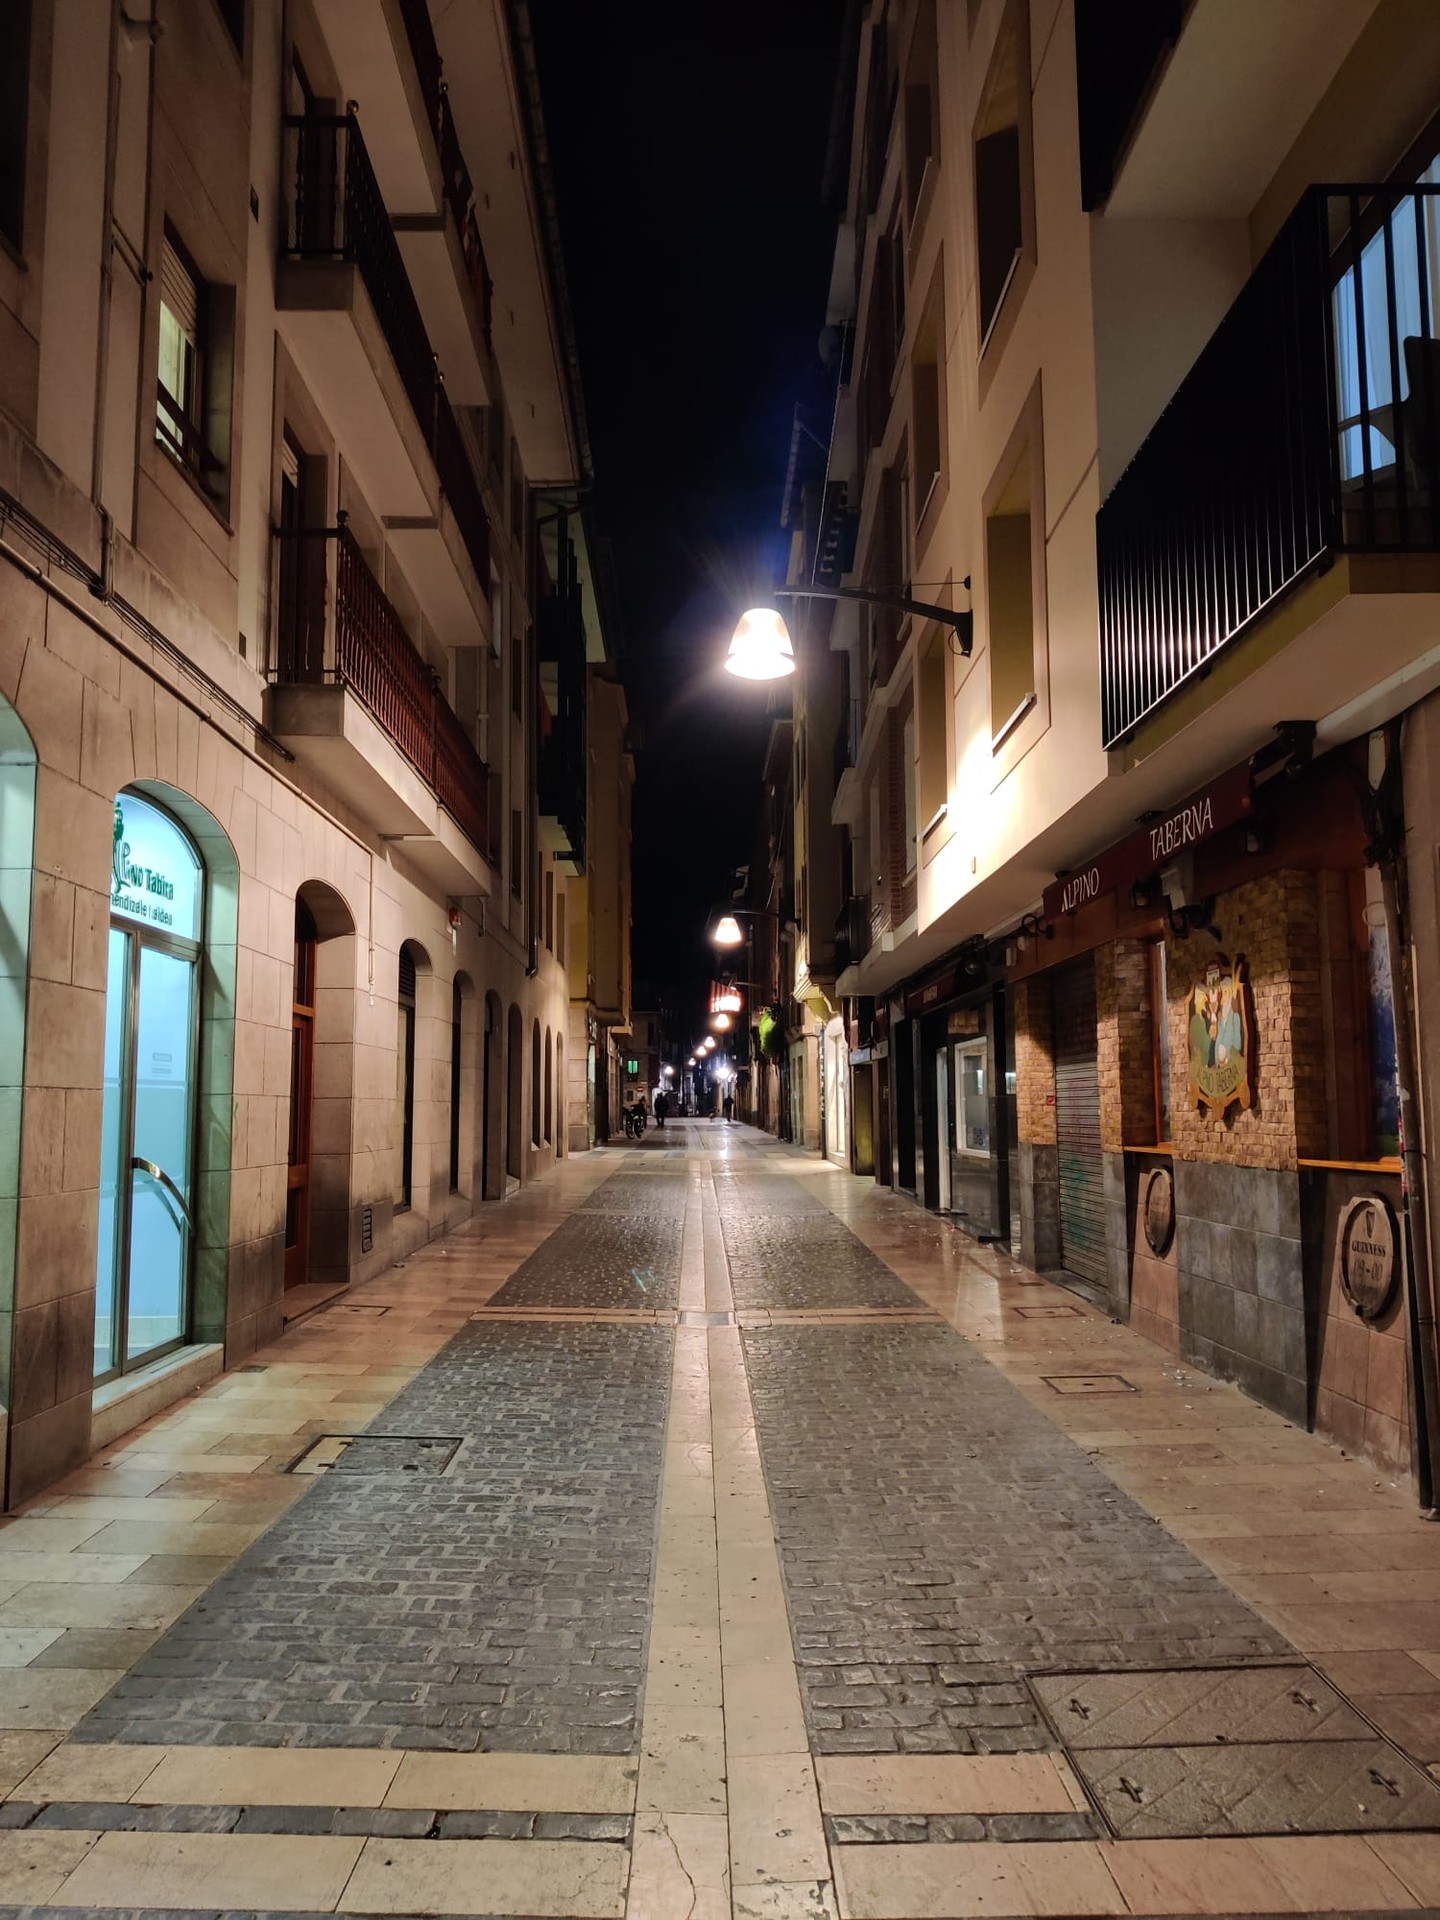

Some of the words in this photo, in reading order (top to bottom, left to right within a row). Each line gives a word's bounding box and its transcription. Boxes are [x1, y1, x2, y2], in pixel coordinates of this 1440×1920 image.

[1061, 867, 1100, 913] ALPINO
[1150, 797, 1214, 861] TABERNA
[1352, 1240, 1387, 1257] GUINNESS
